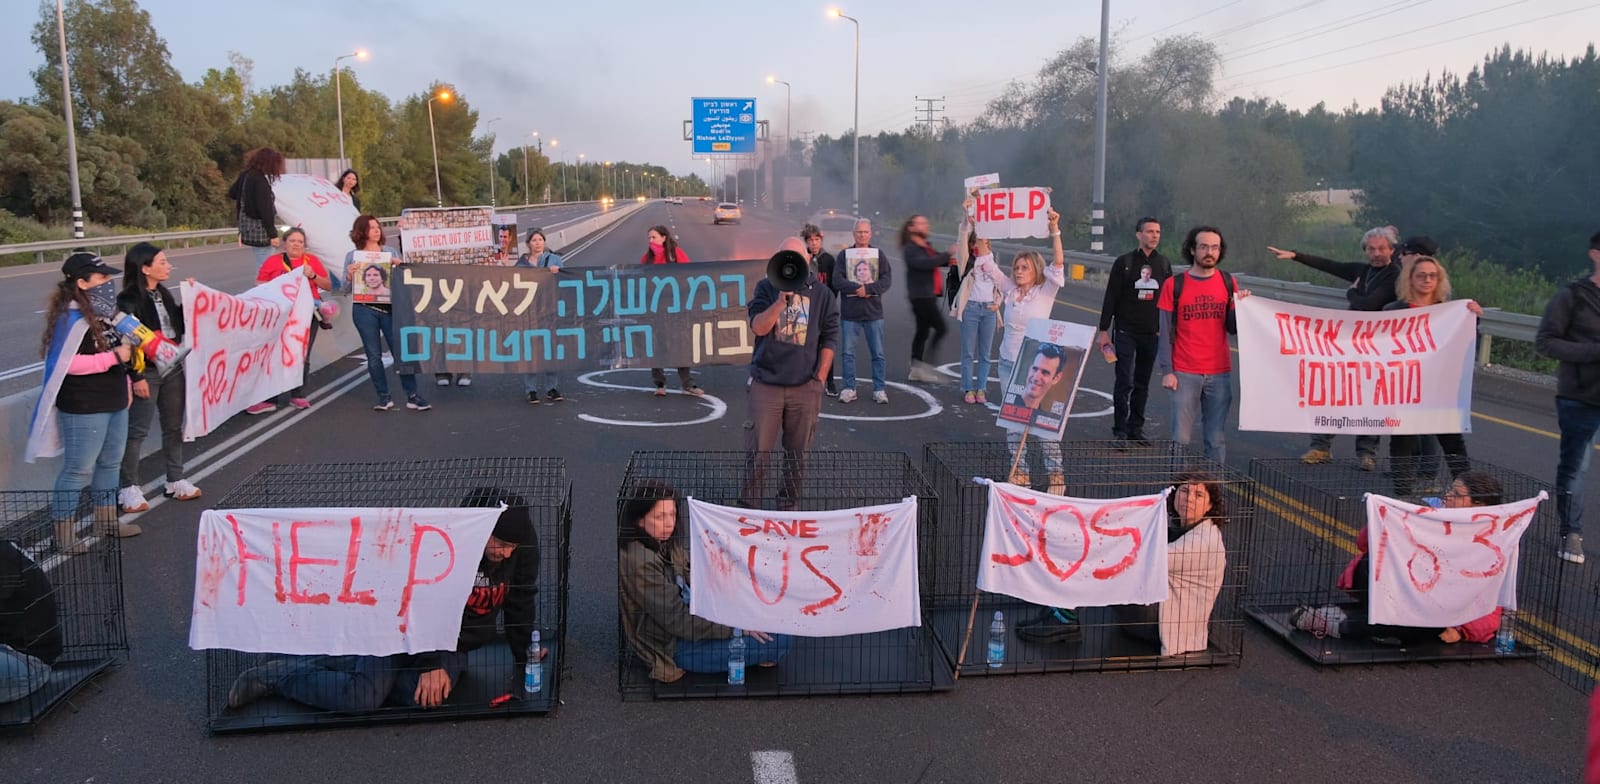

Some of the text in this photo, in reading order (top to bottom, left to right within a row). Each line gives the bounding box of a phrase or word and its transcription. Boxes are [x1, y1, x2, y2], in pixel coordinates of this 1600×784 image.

[976, 190, 1046, 223] HELP
[412, 236, 426, 249] GET
[429, 234, 448, 247] THEM
[450, 232, 461, 245] OUT
[464, 231, 472, 243] OF
[403, 268, 746, 317] הממשלה לא על
[400, 326, 586, 363] החטופים
[602, 324, 654, 358] חיי
[1275, 312, 1437, 357] תוציאו אותם
[1298, 359, 1422, 408] מהגיהנום!
[1314, 415, 1401, 429] #BringThemHomeNow
[738, 516, 819, 539] SAVE
[991, 491, 1156, 582] SOS
[226, 514, 456, 634] HELP
[748, 544, 843, 616] US
